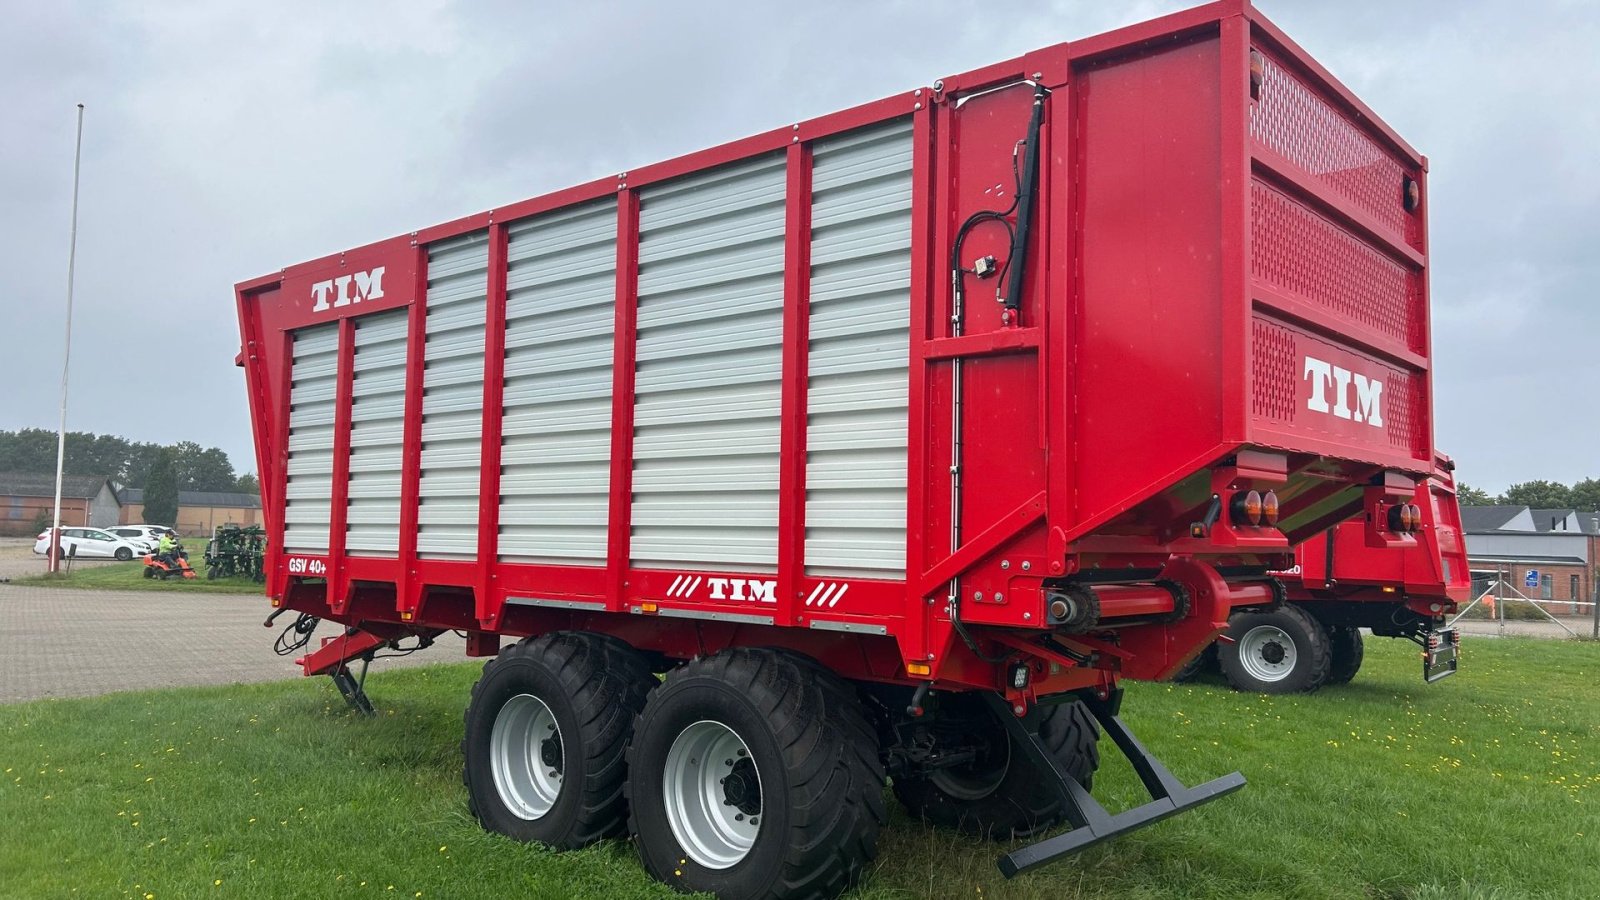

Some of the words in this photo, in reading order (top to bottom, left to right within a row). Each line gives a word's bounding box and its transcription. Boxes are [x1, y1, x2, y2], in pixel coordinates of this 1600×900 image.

[311, 266, 385, 312] TIM
[1304, 356, 1382, 427] TIM
[289, 558, 307, 572] GSV
[309, 560, 326, 574] 40+
[707, 578, 777, 603] TIM
